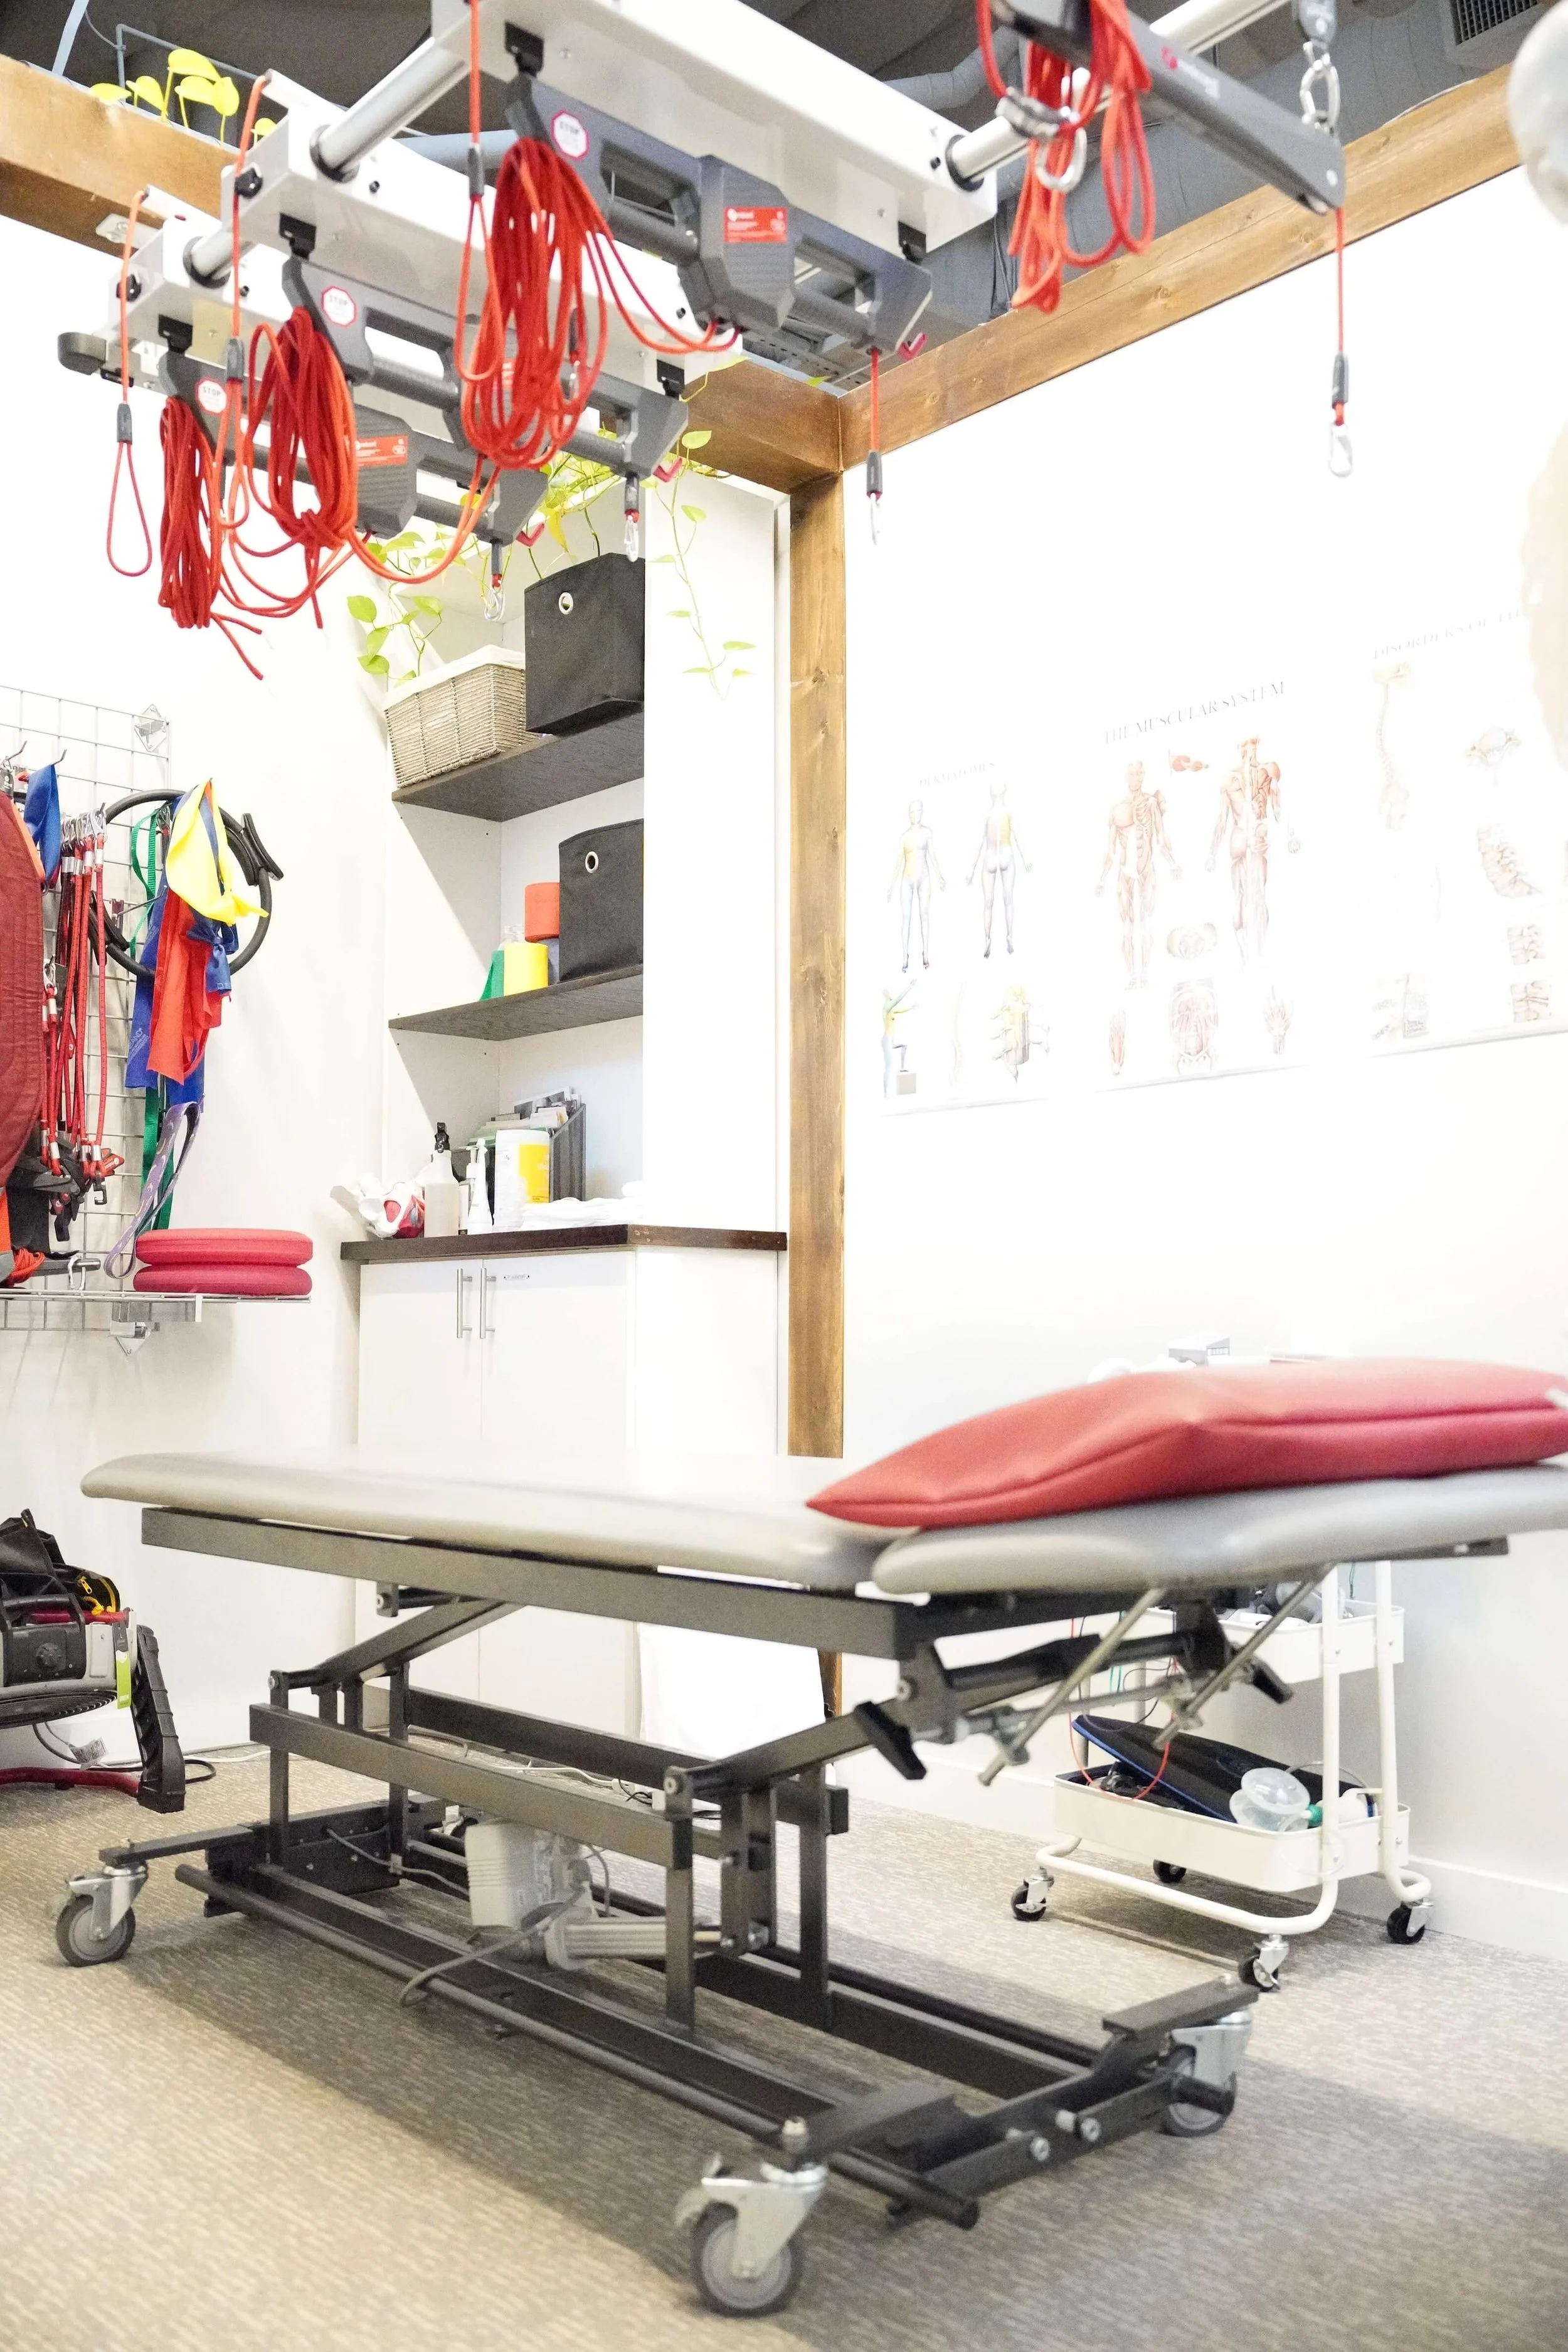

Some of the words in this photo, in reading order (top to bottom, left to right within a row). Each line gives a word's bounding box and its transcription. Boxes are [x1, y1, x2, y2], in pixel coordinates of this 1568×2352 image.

[203, 385, 221, 396] STOP
[1103, 725, 1131, 744] THE
[1136, 699, 1218, 734] MUSCULAR
[1222, 681, 1285, 710] SYSTEM
